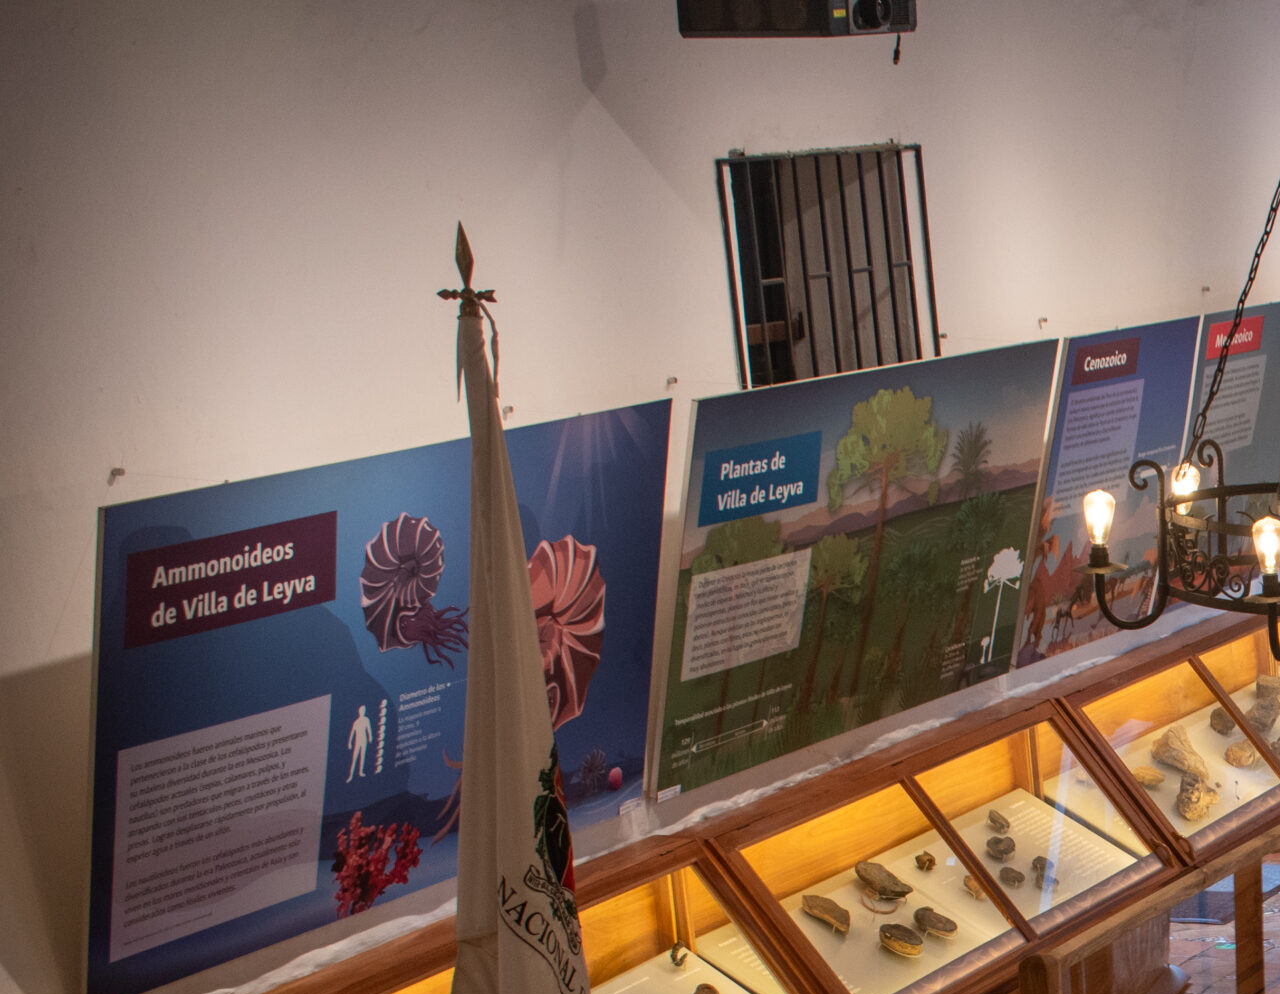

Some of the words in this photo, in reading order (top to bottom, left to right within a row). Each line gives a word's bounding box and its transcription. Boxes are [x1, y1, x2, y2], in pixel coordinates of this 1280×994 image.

[1083, 349, 1128, 372] Cenozoico
[719, 455, 768, 481] Plantas
[770, 451, 786, 471] de
[717, 487, 747, 511] Villa
[750, 485, 765, 505] de
[768, 479, 804, 505] Leyva
[151, 540, 295, 589] Ammonoideos
[151, 601, 178, 628] de
[182, 591, 229, 621] Villa
[233, 585, 259, 610] de
[262, 571, 316, 606] Leyva
[497, 876, 576, 993] NACIONAL
